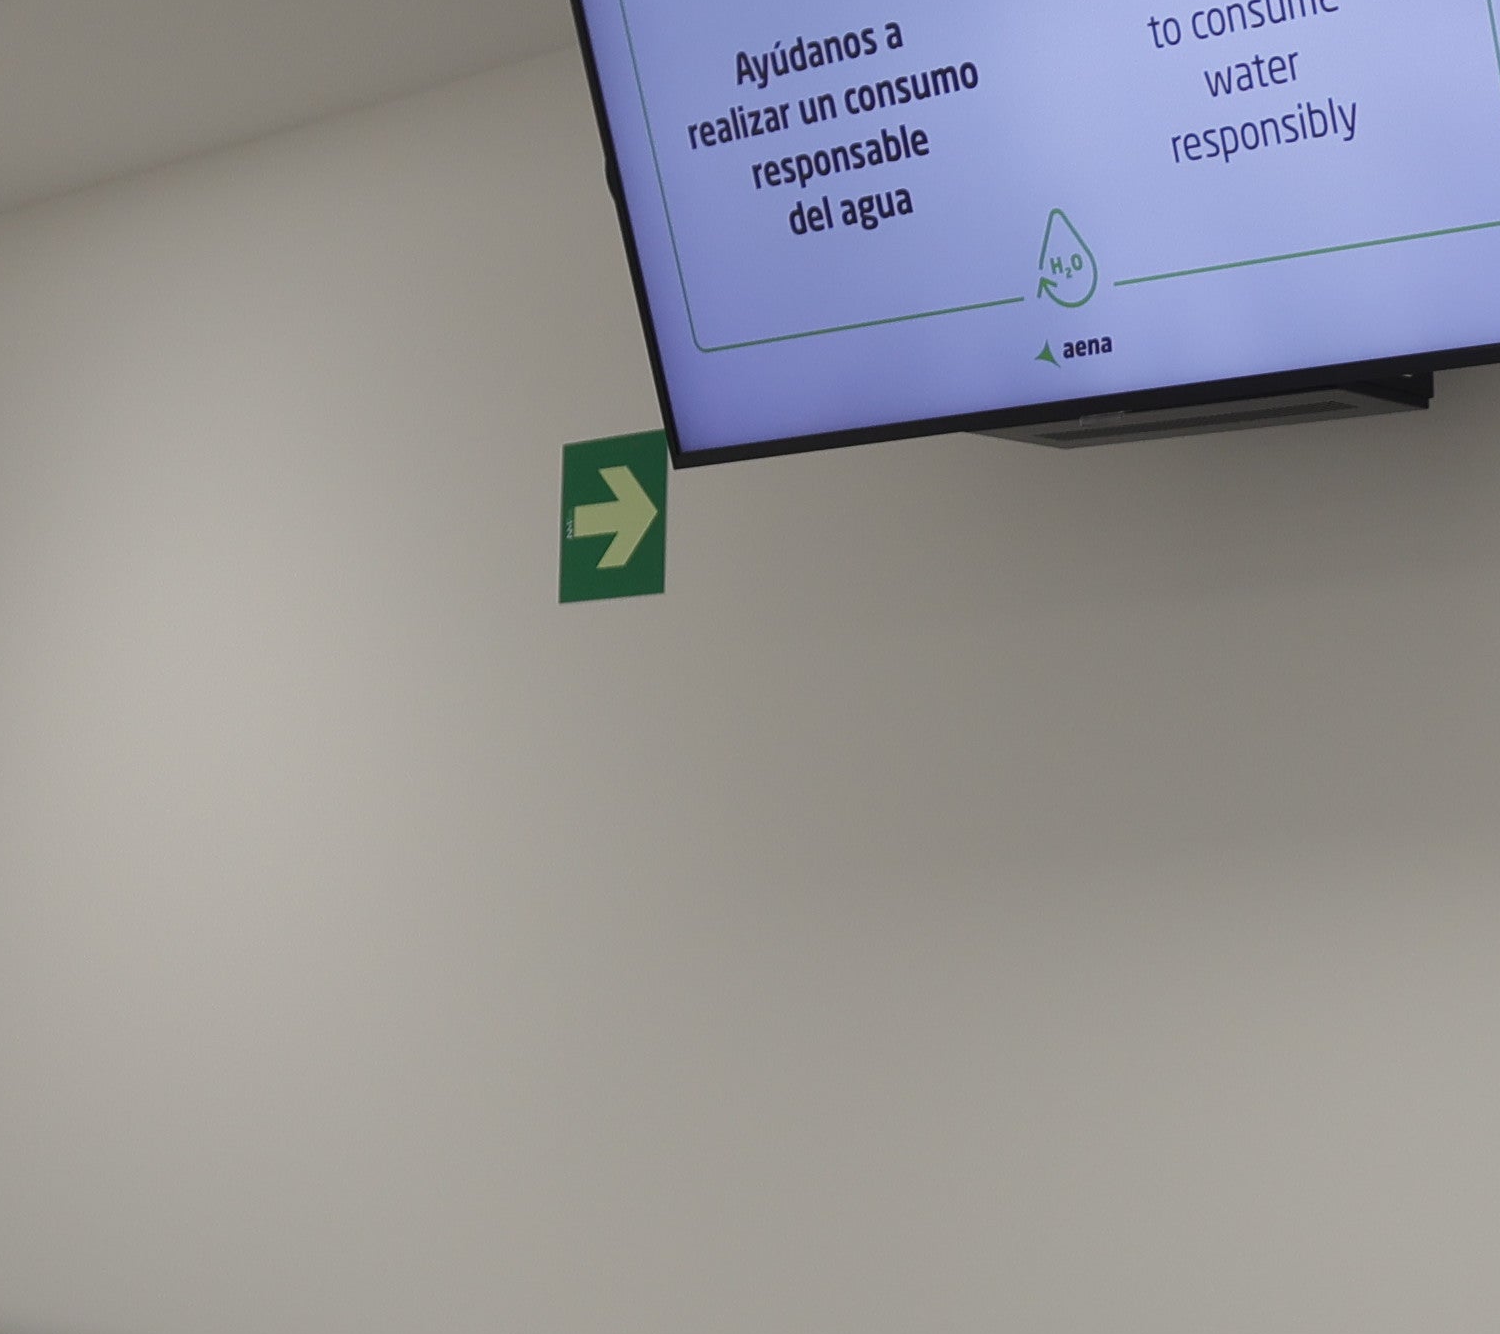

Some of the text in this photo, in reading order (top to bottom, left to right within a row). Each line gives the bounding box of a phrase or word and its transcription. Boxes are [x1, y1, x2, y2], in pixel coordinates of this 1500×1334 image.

[734, 20, 904, 90] Ayúdanos a
[1146, 15, 1182, 49] to
[1203, 51, 1300, 98] water
[686, 60, 980, 151] realizar un consumo
[1171, 97, 1357, 163] responsibly
[750, 124, 931, 190] responsable
[788, 187, 915, 236] del agua
[1062, 335, 1114, 359] aena
